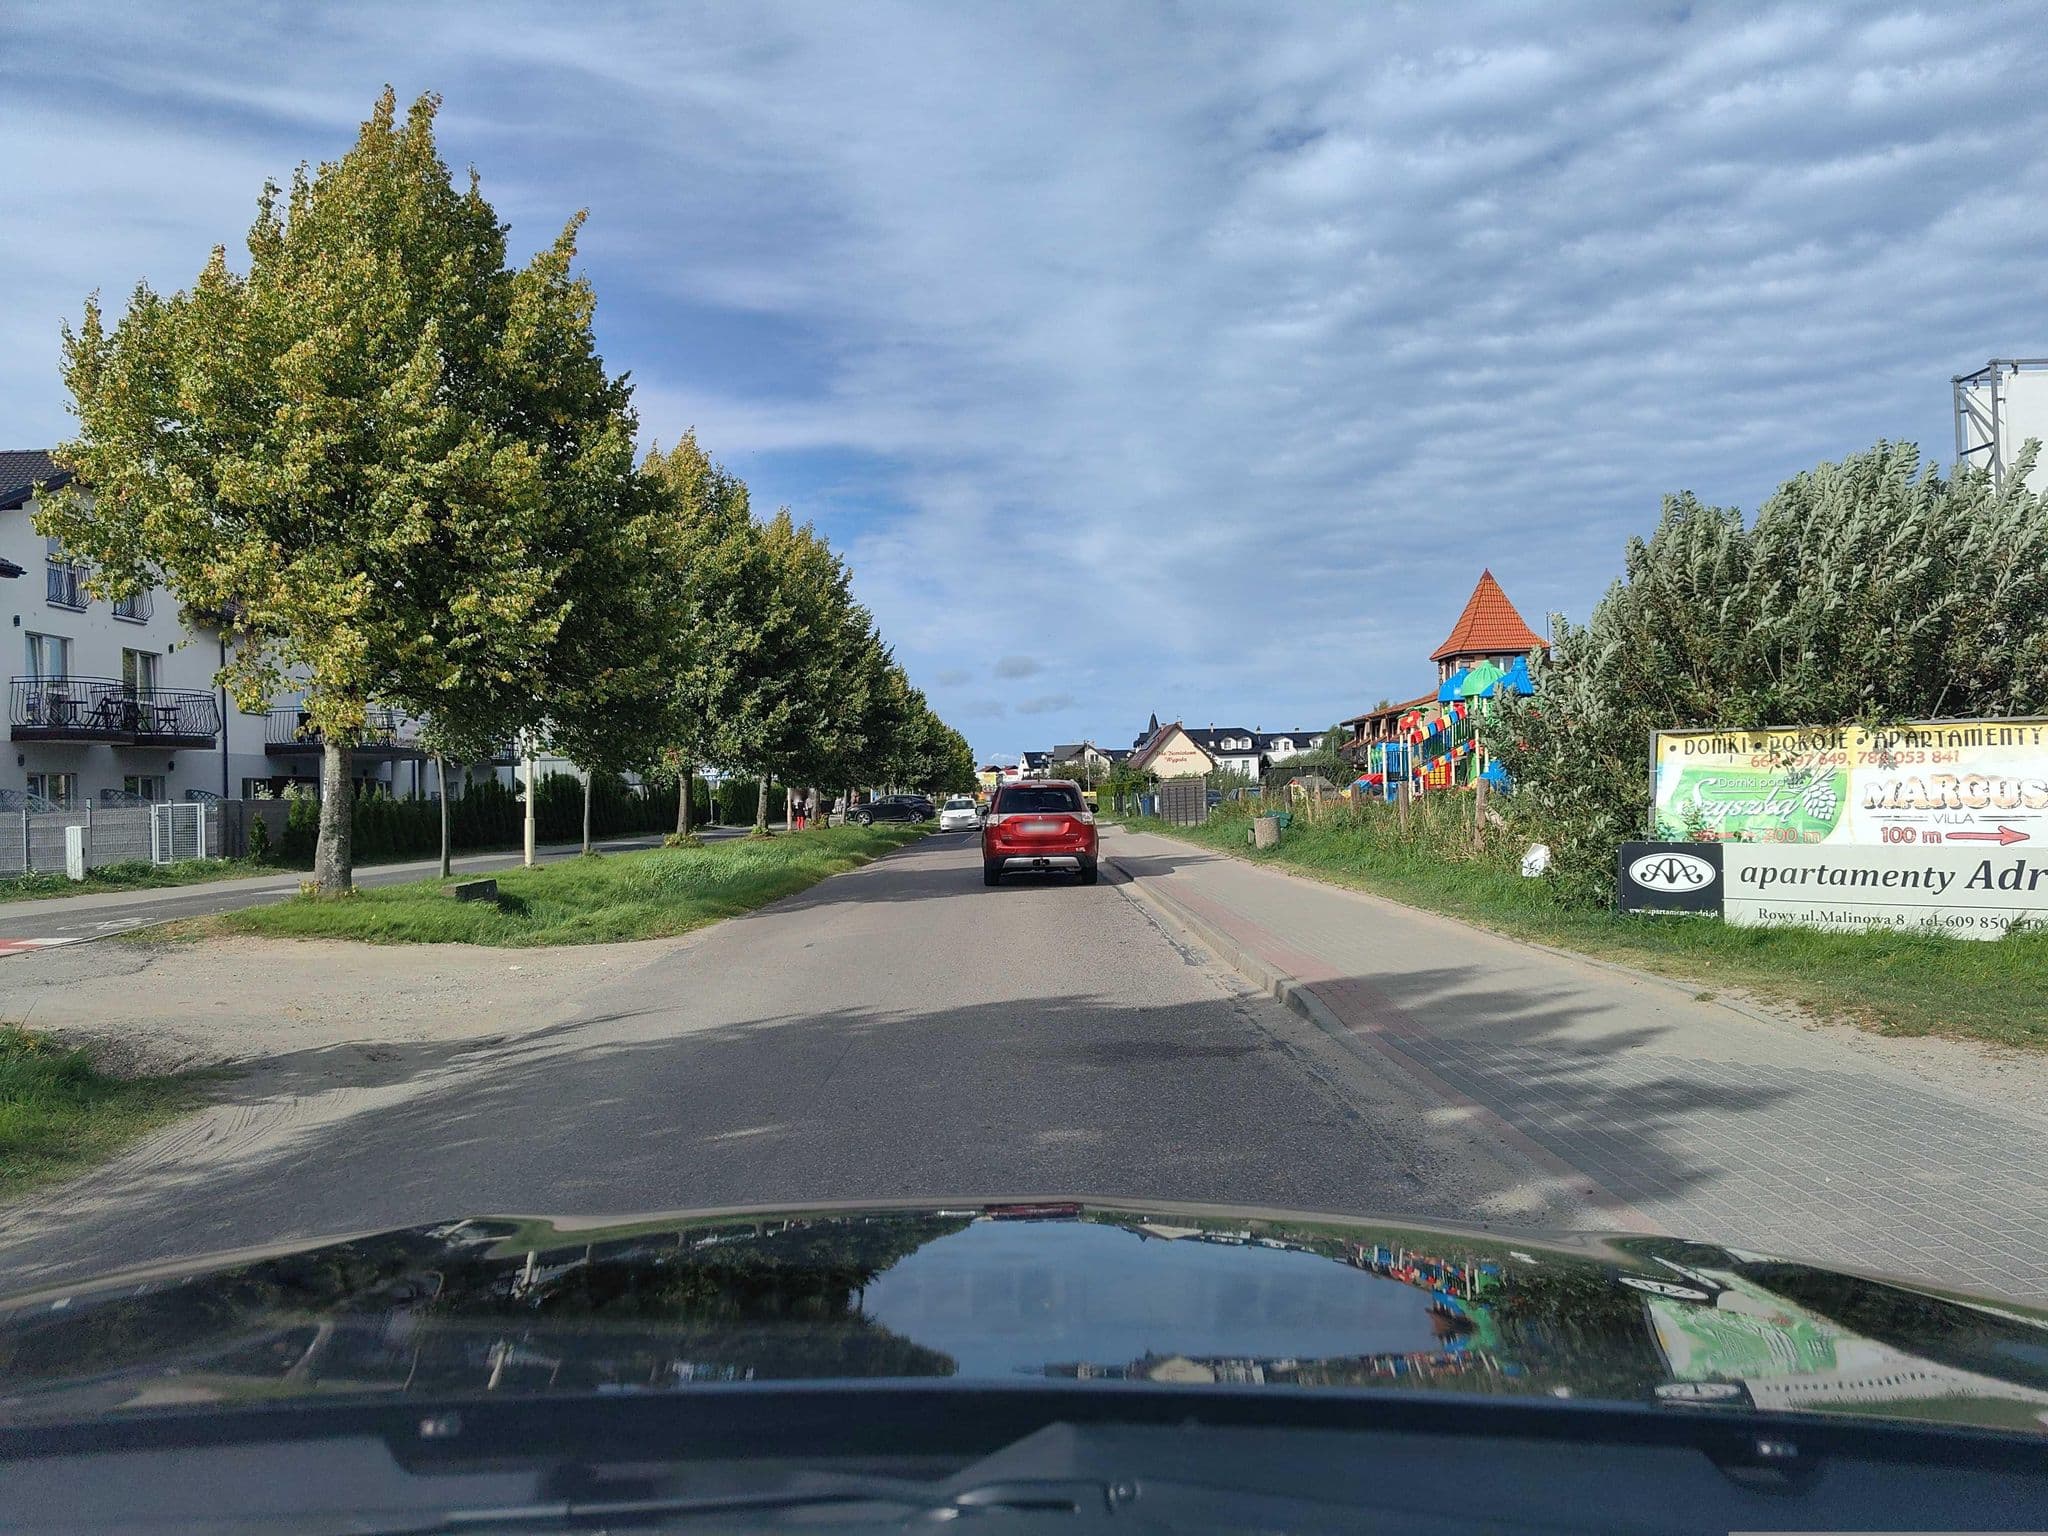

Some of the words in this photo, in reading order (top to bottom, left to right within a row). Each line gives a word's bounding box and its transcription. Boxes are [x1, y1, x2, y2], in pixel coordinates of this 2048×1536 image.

[1684, 736, 1746, 755] DOMKI
[1769, 732, 1848, 752] POKOJE
[1874, 727, 2043, 748] APARTAMENTY
[1932, 750, 1960, 763] 841
[1718, 777, 1757, 789] Domki
[1863, 773, 2048, 809] MARCUS
[1677, 777, 1802, 827] Szyszką
[1932, 814, 1975, 824] VILLA
[1881, 827, 1916, 843] 100
[1922, 831, 1942, 843] m
[1740, 863, 1956, 896] apartamenty
[1758, 908, 1796, 923] Rowy
[1896, 914, 1905, 925] 8
[1980, 916, 2010, 929] 850
